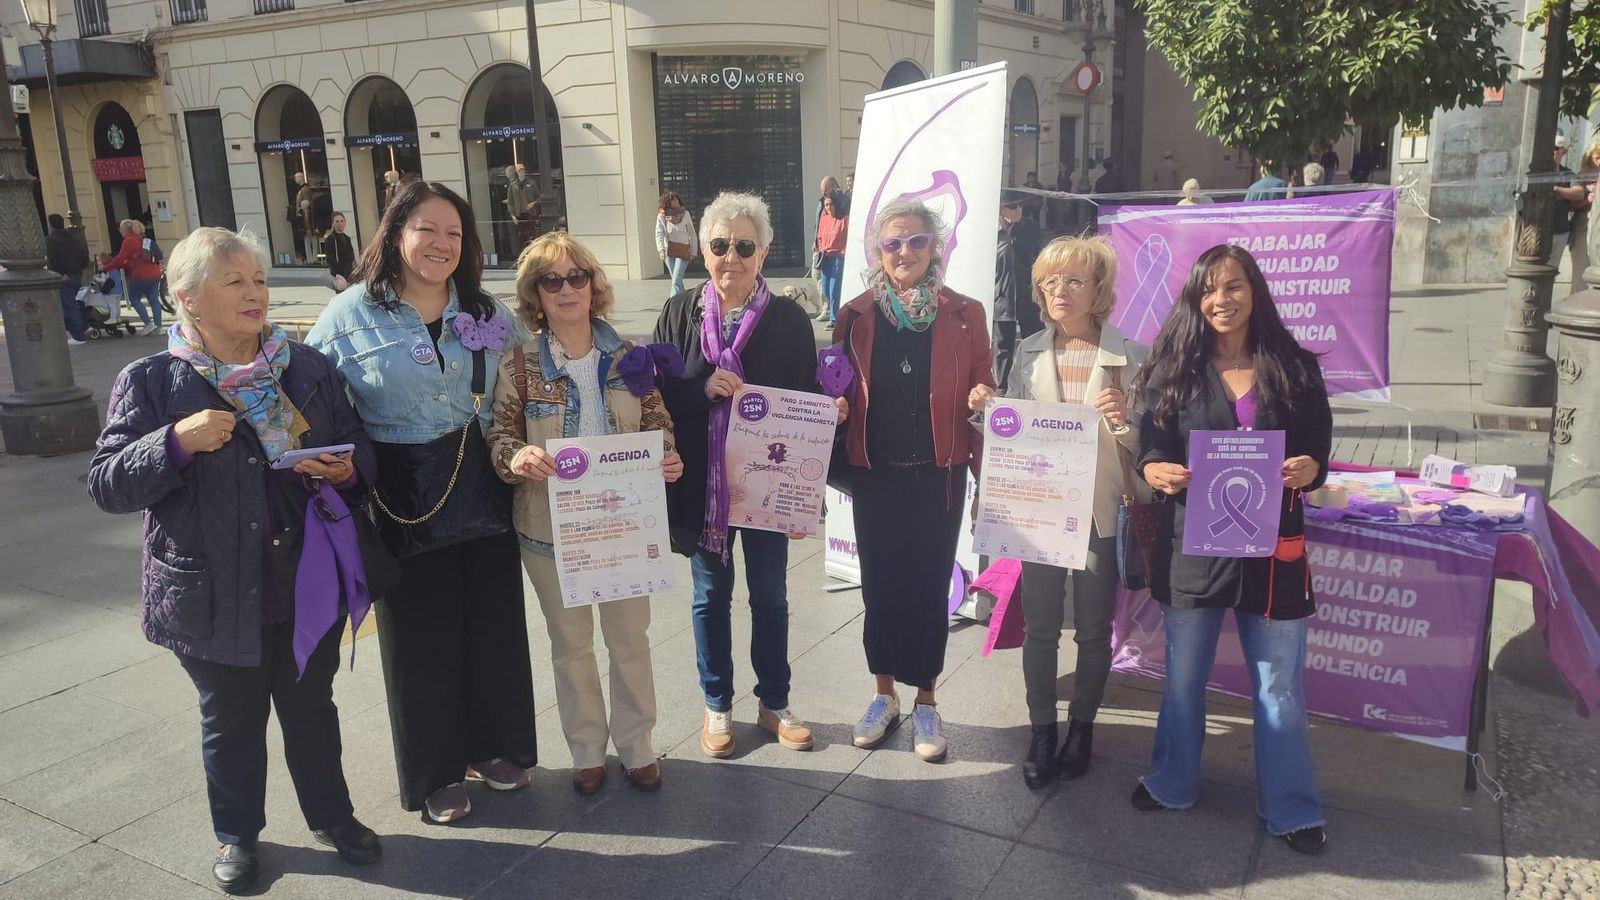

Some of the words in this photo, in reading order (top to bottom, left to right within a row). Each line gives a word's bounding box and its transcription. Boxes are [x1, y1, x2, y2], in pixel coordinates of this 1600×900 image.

[664, 73, 720, 84] ALVARO
[745, 72, 805, 83] MORENO
[1256, 256, 1340, 274] GUALDAD
[1266, 278, 1351, 296] ONSTRUIR
[1275, 302, 1317, 319] NDO
[414, 347, 432, 356] CTA
[743, 404, 762, 413] 25N
[787, 406, 812, 415] CONTRA
[804, 400, 831, 408] MINUTOS
[771, 412, 802, 421] VIOLENCIA
[803, 416, 835, 426] MACHISTA
[994, 416, 1014, 426] 25N
[1031, 418, 1083, 432] AGENDA
[560, 456, 581, 469] 25N
[599, 449, 650, 464] AGENDA
[829, 536, 858, 560] www.p
[1306, 546, 1404, 578] ABAJAR
[1311, 575, 1417, 608] GUALDAD
[1314, 603, 1431, 638] ONSTRUIR
[1307, 628, 1384, 657] MUNDO
[1305, 652, 1407, 686] IOLENCIA
